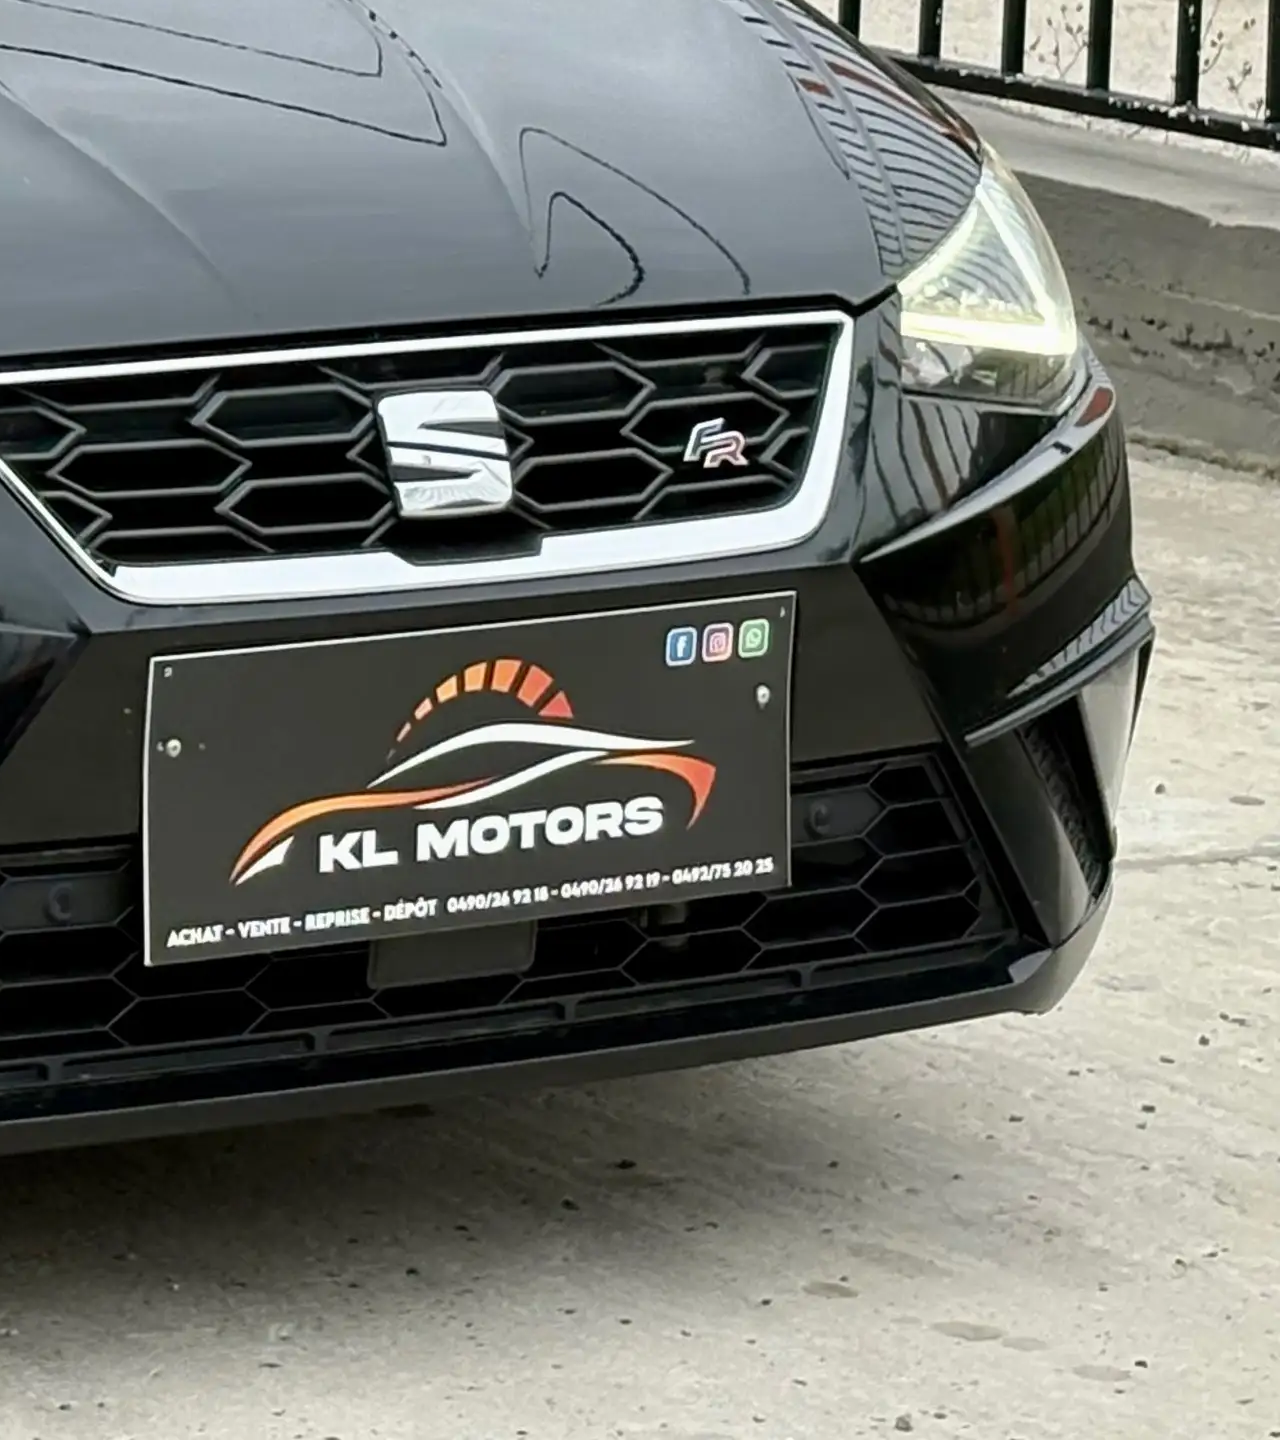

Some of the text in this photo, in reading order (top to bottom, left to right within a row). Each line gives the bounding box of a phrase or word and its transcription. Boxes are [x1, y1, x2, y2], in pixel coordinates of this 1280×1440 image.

[318, 796, 665, 873] KL MOTORS
[166, 924, 224, 948] ACHAT
[237, 916, 291, 939] VENTE
[304, 906, 371, 932] REPRISE
[383, 896, 438, 922] DÉPÔT
[733, 859, 754, 878] 20
